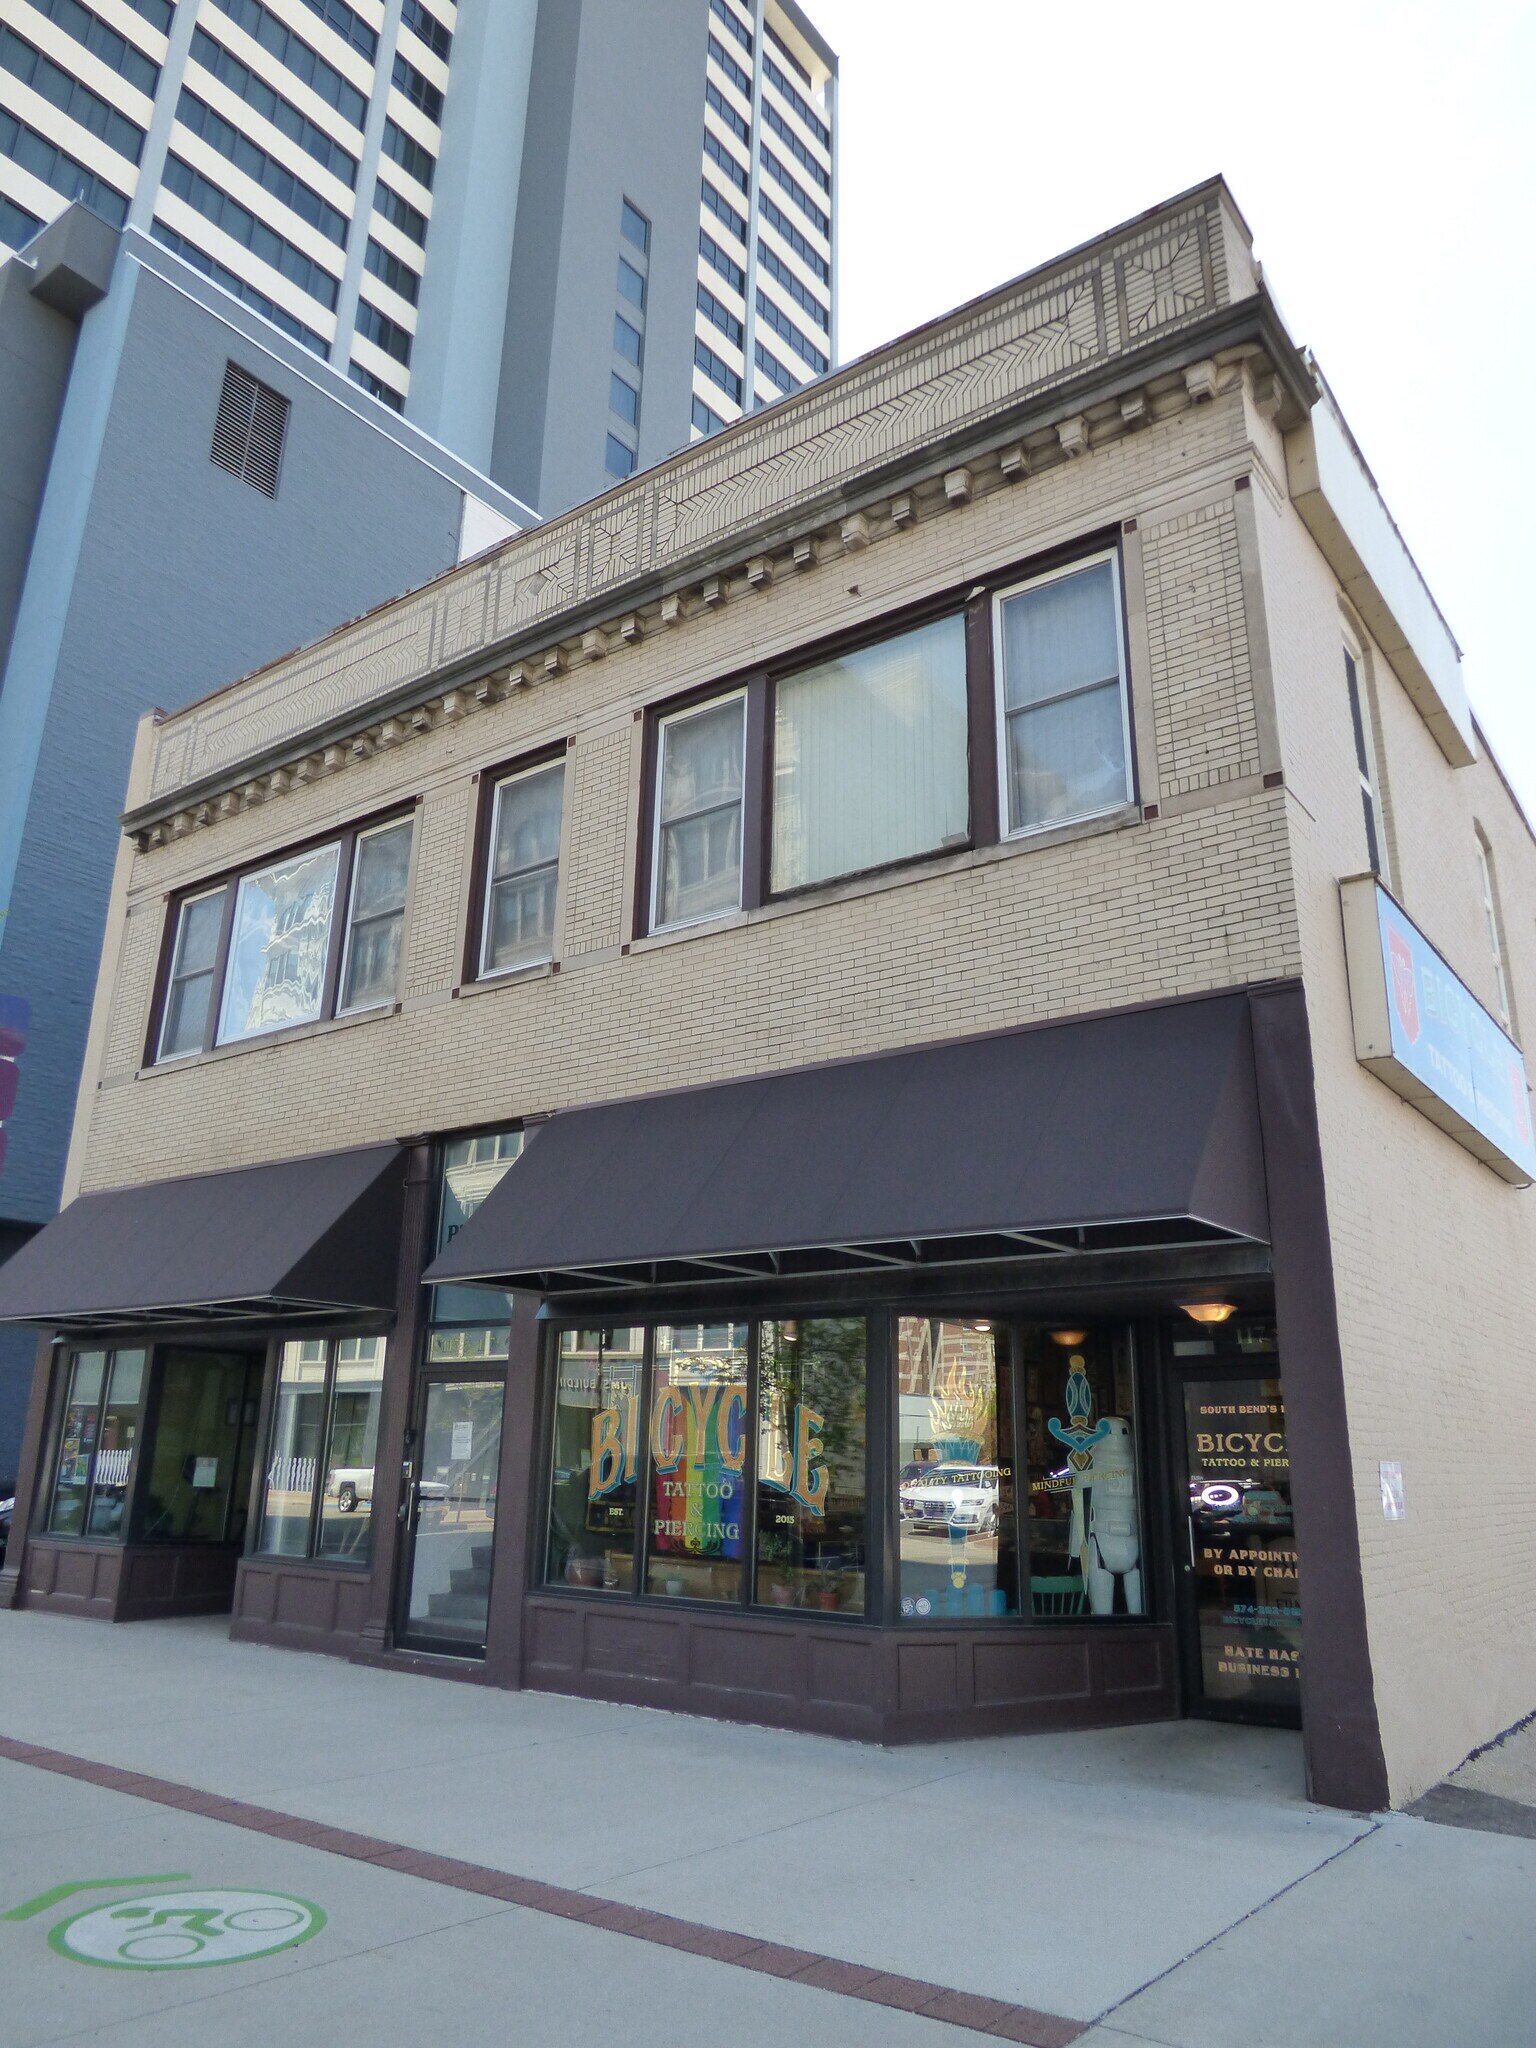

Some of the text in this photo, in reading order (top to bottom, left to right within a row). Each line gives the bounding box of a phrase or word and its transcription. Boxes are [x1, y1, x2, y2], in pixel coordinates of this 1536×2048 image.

[1200, 1406, 1236, 1414] SOUTH
[1239, 1404, 1278, 1414] BEND'S
[588, 1382, 829, 1516] BICYCLE
[1196, 1432, 1288, 1453] BICYC
[1202, 1458, 1246, 1467] TATTOO
[1250, 1458, 1260, 1467] &
[951, 1467, 1012, 1484] TATTOOING
[663, 1481, 733, 1500] TATTOO
[609, 1507, 624, 1516] EST.
[690, 1504, 704, 1518] &
[654, 1519, 740, 1540] PIERCING
[1203, 1548, 1223, 1559] BY
[1214, 1564, 1234, 1575] OR
[1238, 1565, 1258, 1577] BY
[1224, 1645, 1264, 1659] HATE
[1217, 1661, 1290, 1678] BUSINESS
